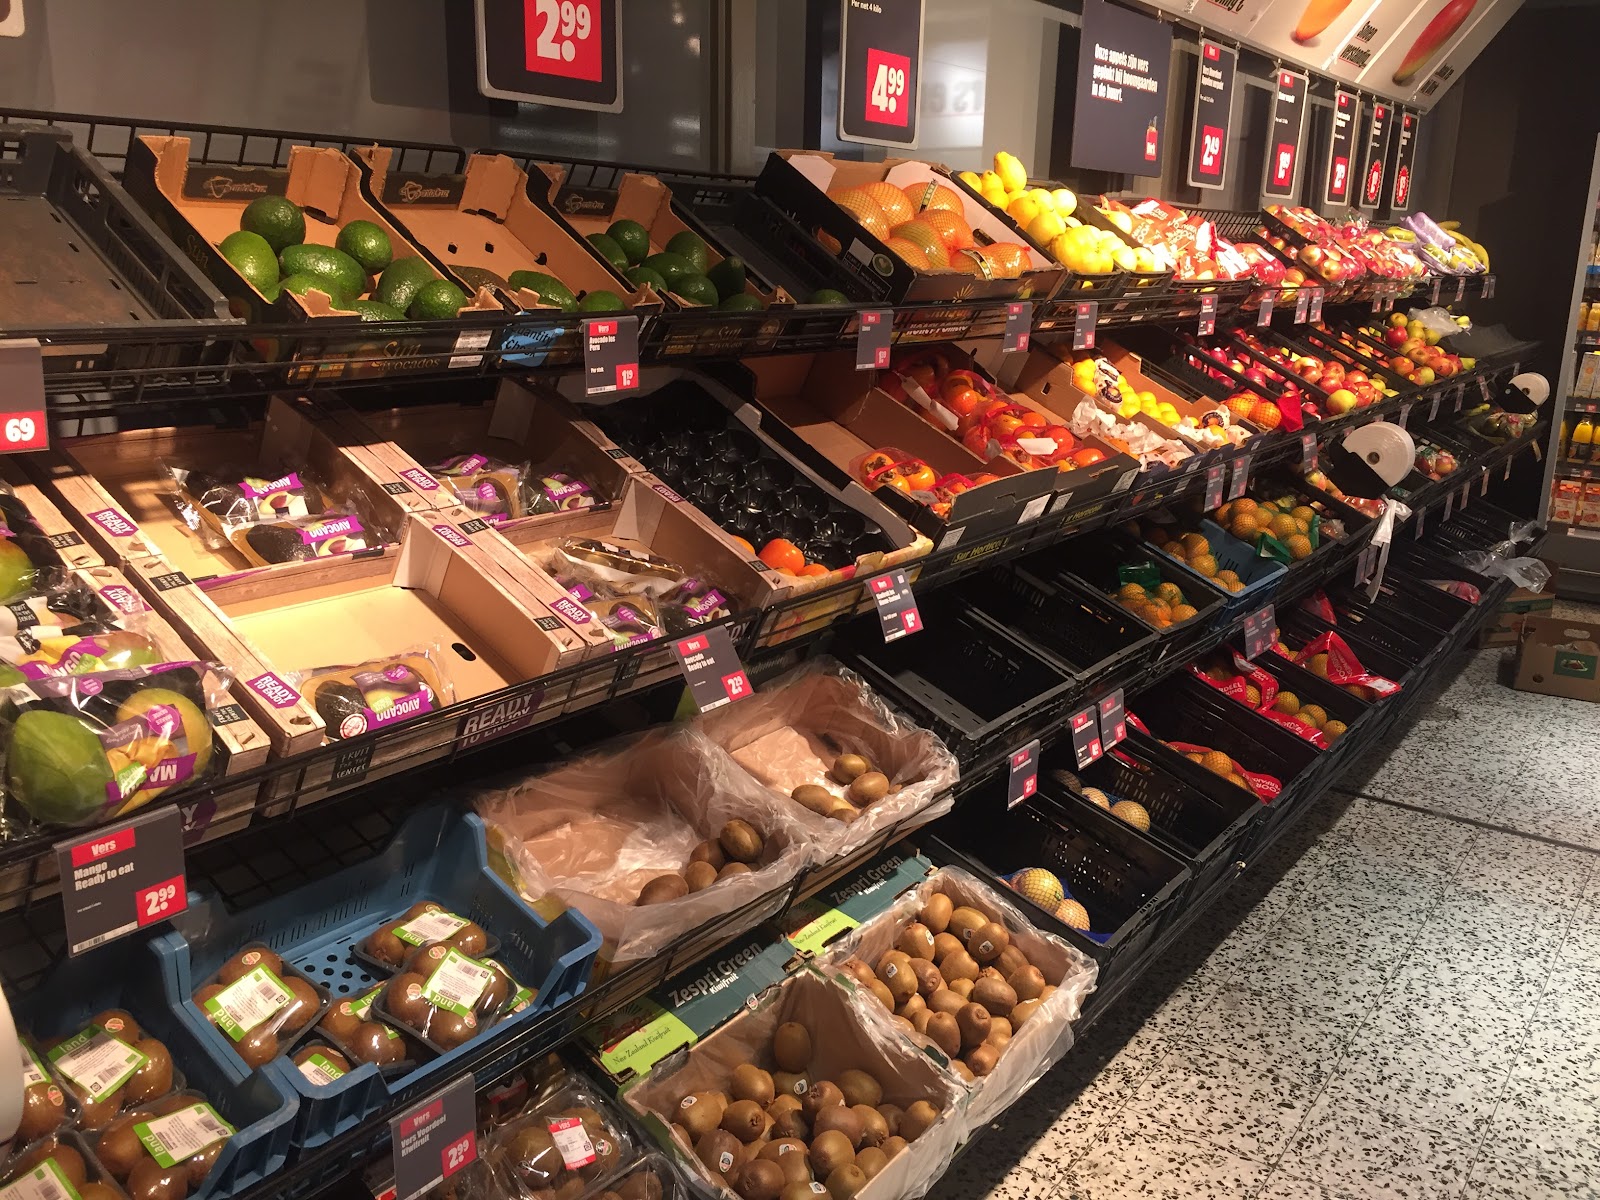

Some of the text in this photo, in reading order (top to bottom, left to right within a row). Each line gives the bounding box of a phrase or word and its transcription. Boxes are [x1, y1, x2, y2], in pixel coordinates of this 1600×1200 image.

[1094, 43, 1149, 72] Onze appels zijn vers
[872, 64, 905, 113] 4.99
[1091, 80, 1099, 96] in
[1098, 82, 1106, 98] de
[1123, 70, 1158, 93] boomgaarden
[589, 336, 607, 345] Avocado
[100, 510, 134, 533] READY
[309, 520, 351, 539] AVOCADO
[559, 600, 589, 620] READY
[684, 652, 705, 666] Avocado
[687, 661, 701, 672] Ready
[254, 680, 287, 705] TO ENJOY
[260, 675, 296, 701] READY
[376, 698, 420, 722] AVOCADO
[463, 694, 533, 736] READY
[91, 840, 117, 857] Vers
[74, 861, 108, 880] Mango
[75, 862, 134, 891] Ready to eat
[866, 855, 904, 880] Green
[145, 884, 176, 916] 2.99
[668, 942, 763, 1008] Zespri Green
[708, 972, 740, 995] Kiwifruit
[432, 994, 458, 1011] land
[213, 1008, 237, 1033] land
[59, 1034, 88, 1052] land
[612, 1026, 671, 1065] New Zealand Kiwifruit
[413, 1111, 430, 1127] Vers
[401, 1114, 447, 1149] Vers Voordeel
[143, 1133, 167, 1158] land
[401, 1134, 430, 1158] Kiwifruit
[447, 1139, 470, 1169] 2.99
